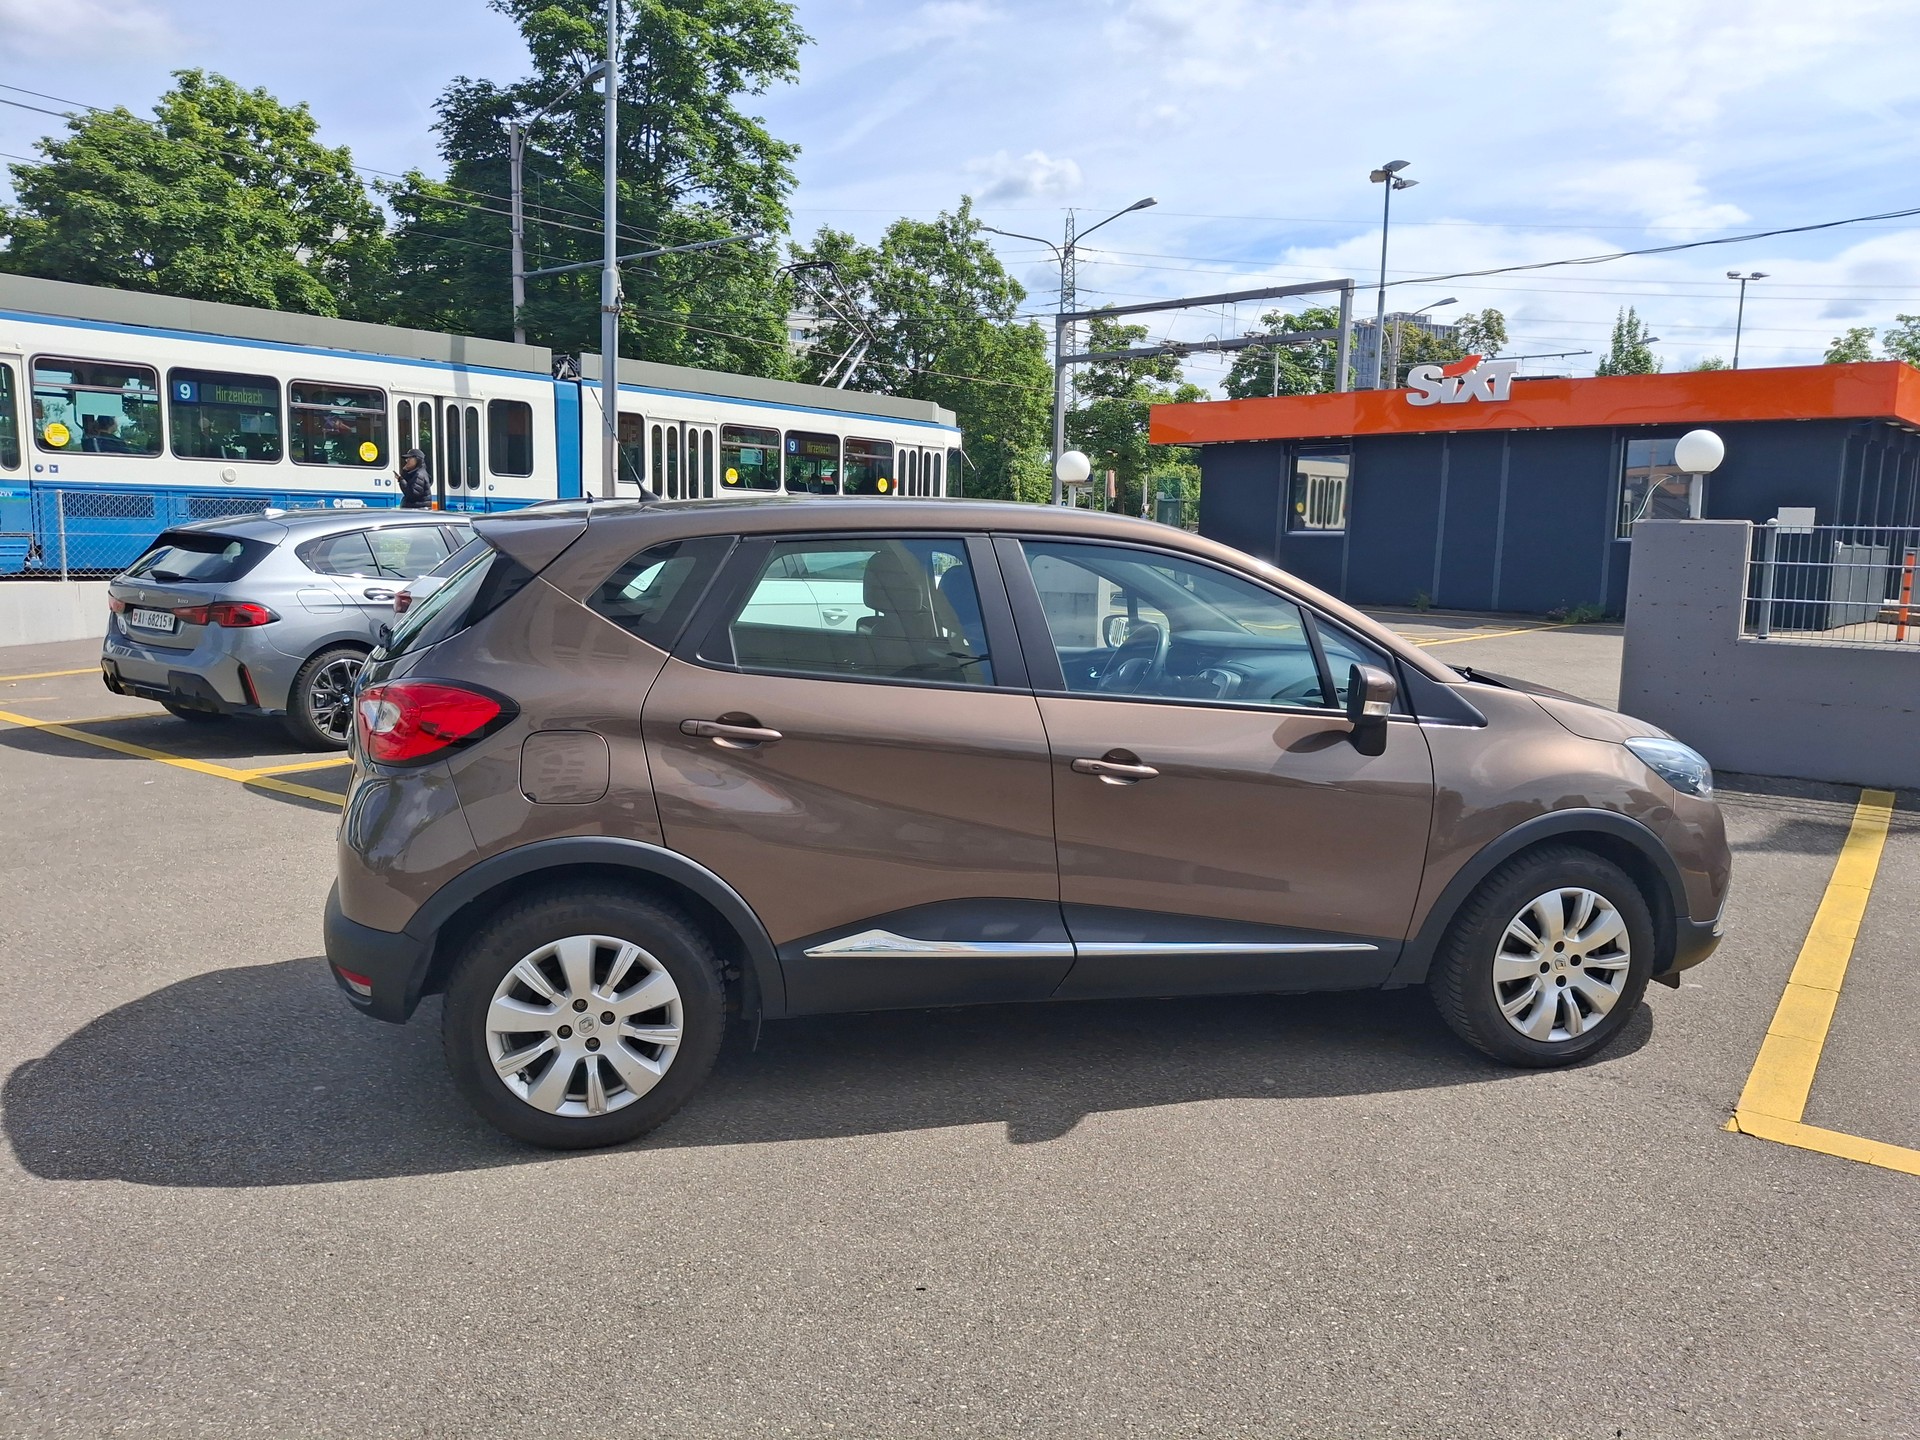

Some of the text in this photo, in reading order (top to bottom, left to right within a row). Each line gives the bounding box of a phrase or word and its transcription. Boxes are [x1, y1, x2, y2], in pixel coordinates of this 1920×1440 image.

[180, 384, 263, 404] 9 Hirzenbach
[790, 441, 796, 451] 9
